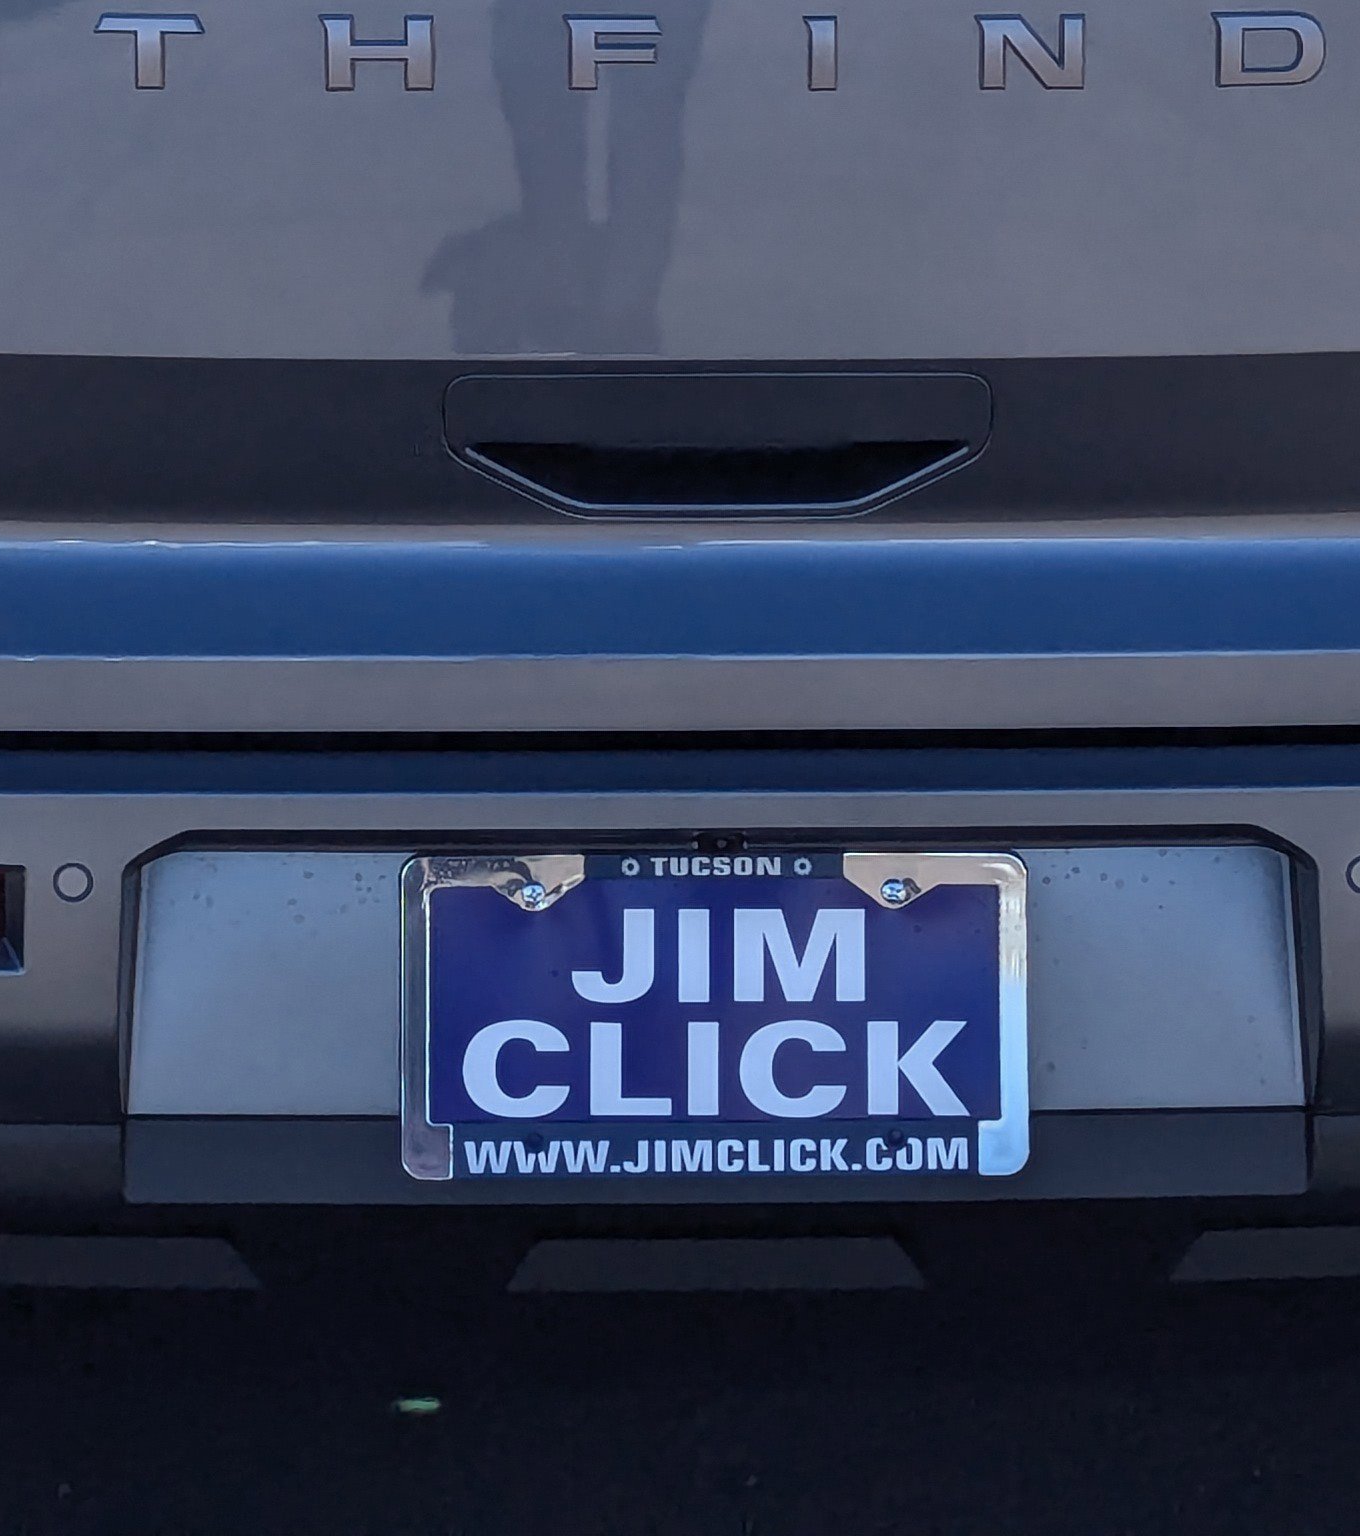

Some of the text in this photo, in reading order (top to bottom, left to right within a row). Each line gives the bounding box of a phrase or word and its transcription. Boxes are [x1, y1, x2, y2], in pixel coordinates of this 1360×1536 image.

[650, 856, 782, 877] TUCSON
[571, 908, 867, 1004] JIM
[462, 1019, 972, 1119] CLICK
[463, 1136, 970, 1175] WWW.JIMCLICK.COM
